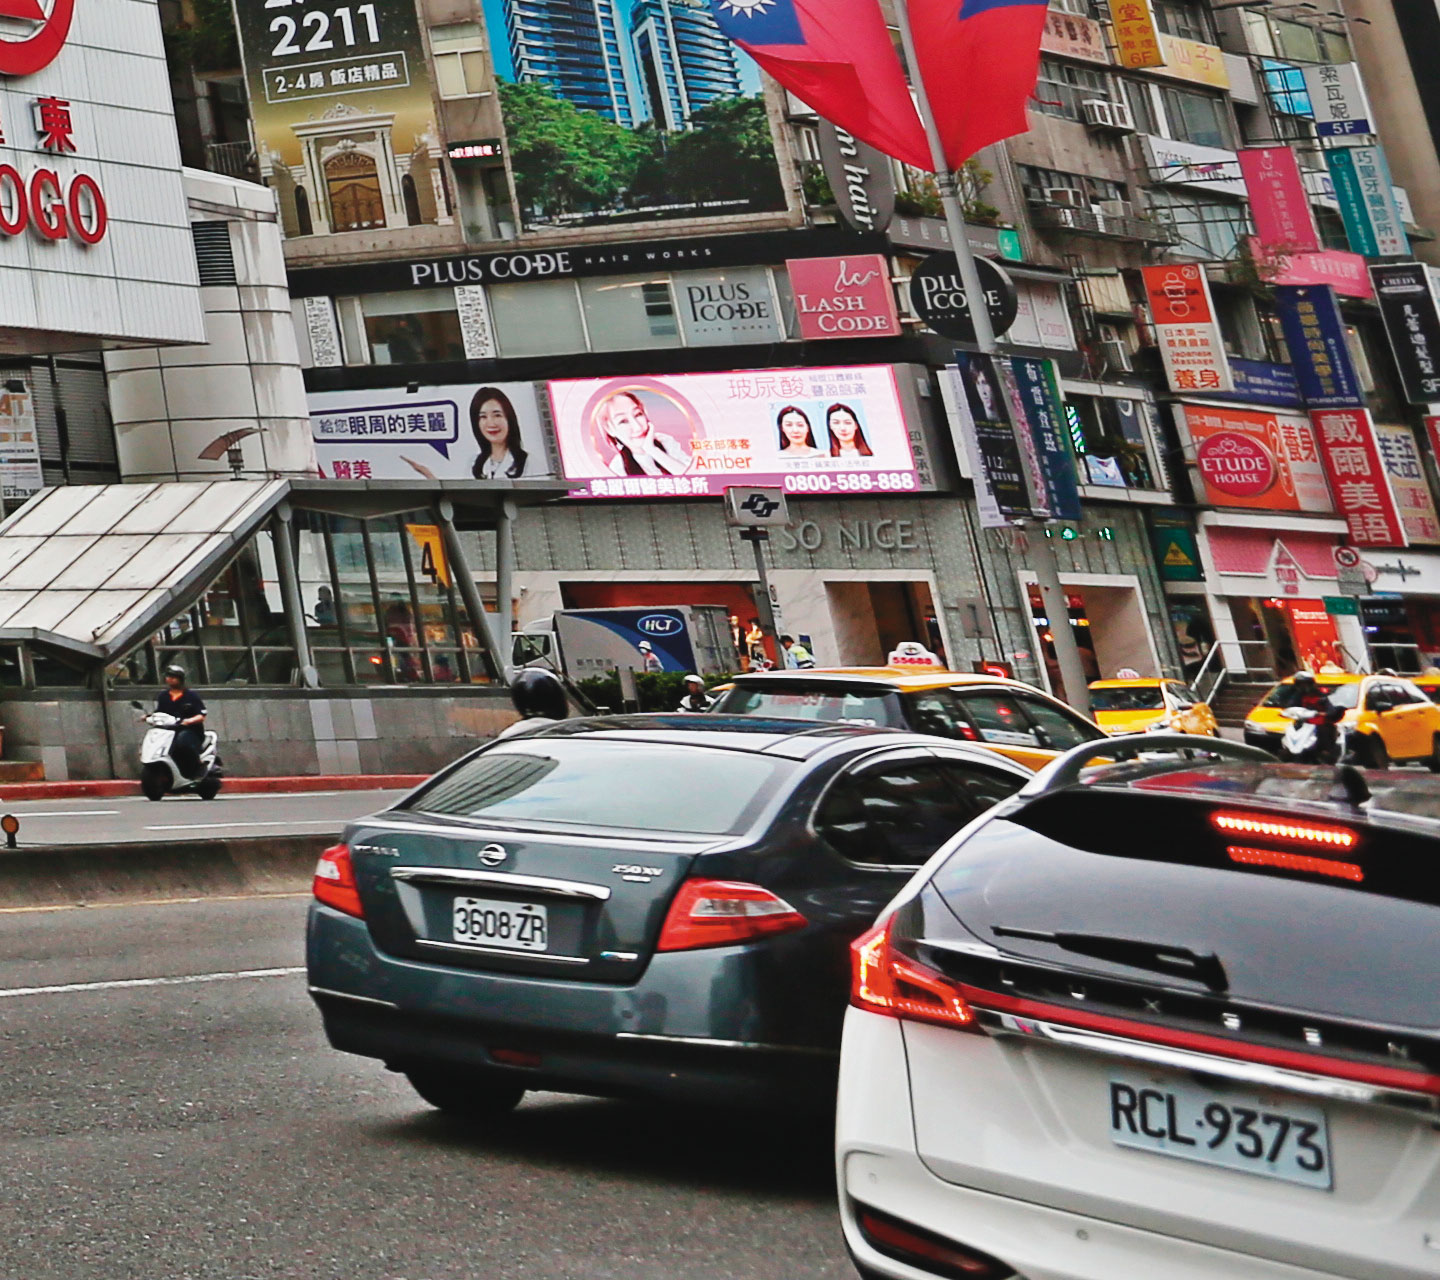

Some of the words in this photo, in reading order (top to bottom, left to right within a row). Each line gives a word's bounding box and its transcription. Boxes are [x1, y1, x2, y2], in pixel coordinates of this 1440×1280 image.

[270, 3, 380, 56] 2211
[1332, 121, 1354, 135] 5F
[411, 258, 483, 287] PLUS
[490, 251, 573, 280] CODE
[798, 294, 865, 313] LASH
[817, 312, 889, 333] CODE
[695, 455, 752, 470] Amber
[1201, 457, 1267, 472] ETUDE
[784, 472, 915, 492] 0800-588-888
[1214, 472, 1261, 484] HOUSE
[781, 521, 823, 551] SO
[420, 541, 438, 584] 4
[1110, 1081, 1326, 1173] RCL-9373
